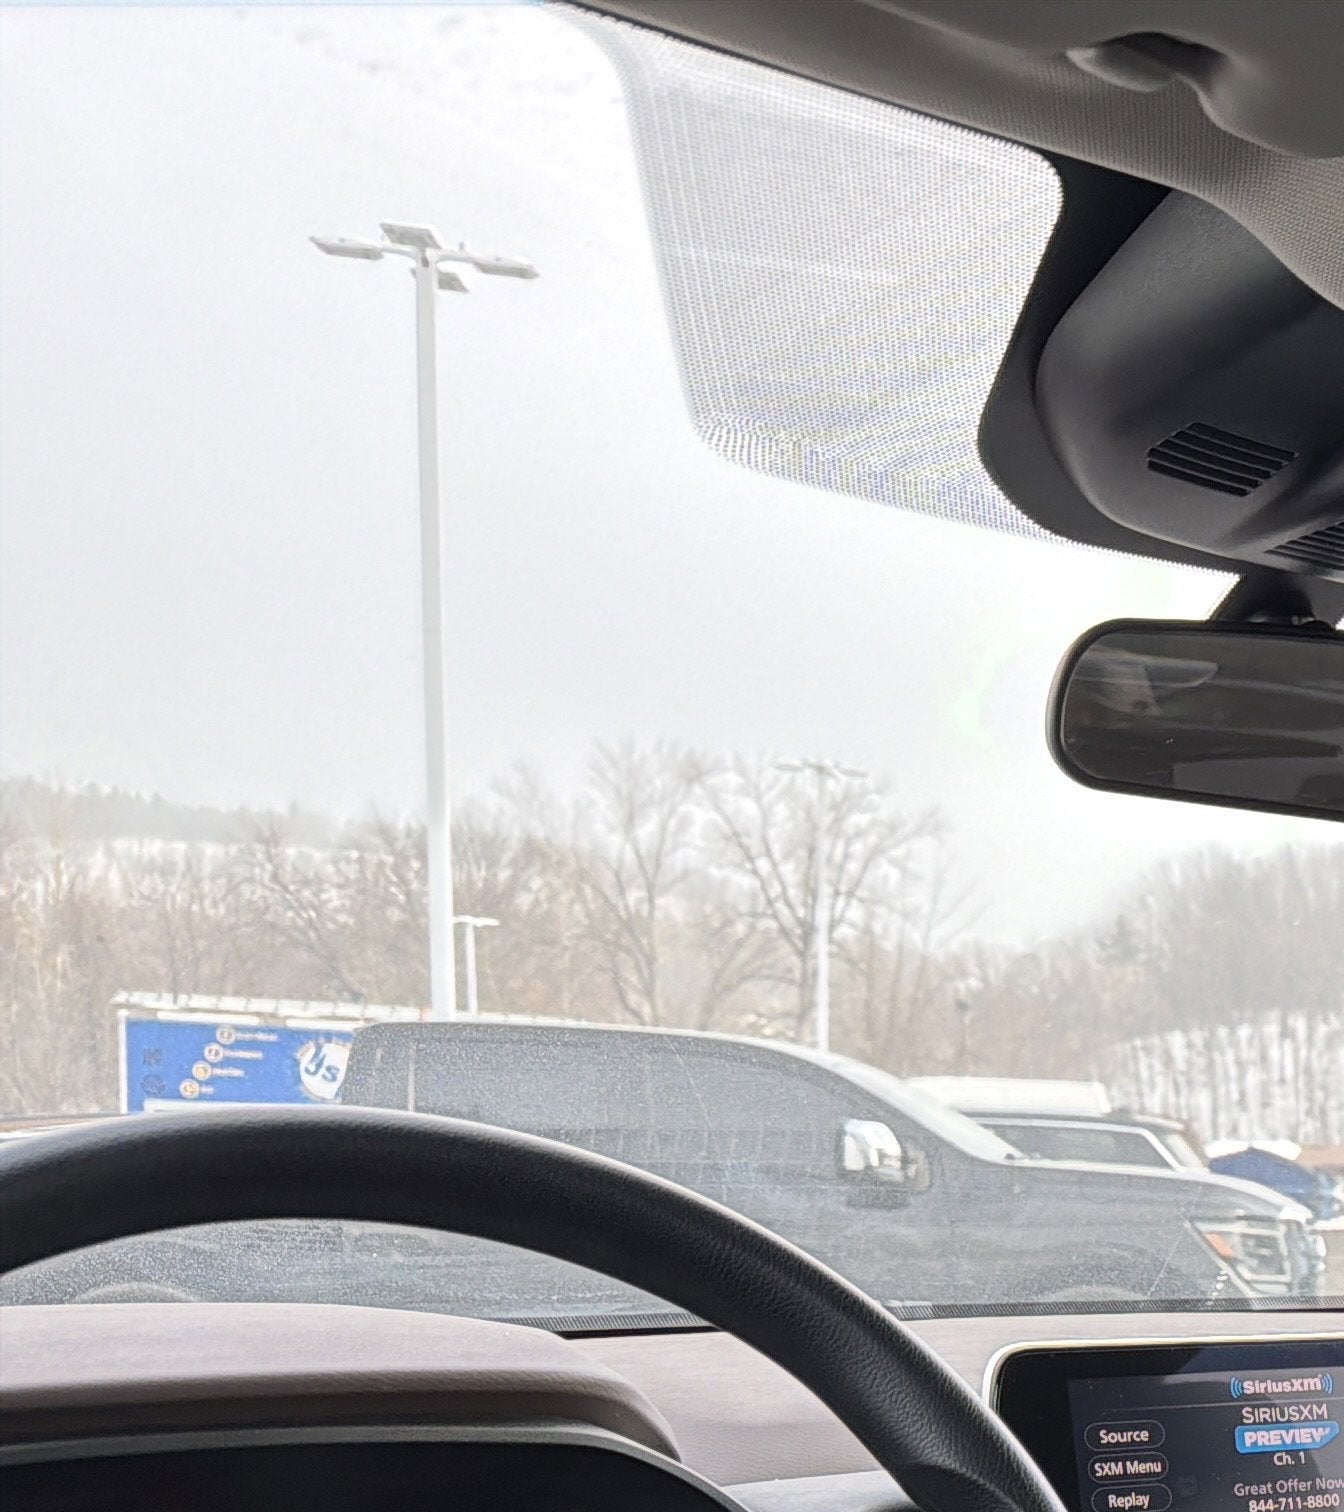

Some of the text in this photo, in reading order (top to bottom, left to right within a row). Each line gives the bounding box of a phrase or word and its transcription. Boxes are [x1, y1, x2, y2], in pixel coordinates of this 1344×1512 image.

[1242, 1403, 1329, 1424] SIRIUSXM
[1100, 1429, 1150, 1444] Source
[1244, 1426, 1330, 1447] PREVIEW
[1094, 1460, 1162, 1477] SXM Menu
[1273, 1451, 1306, 1467] Ch. 1
[1234, 1480, 1274, 1497] Great
[1276, 1477, 1312, 1494] Offer
[1108, 1492, 1151, 1511] Replay
